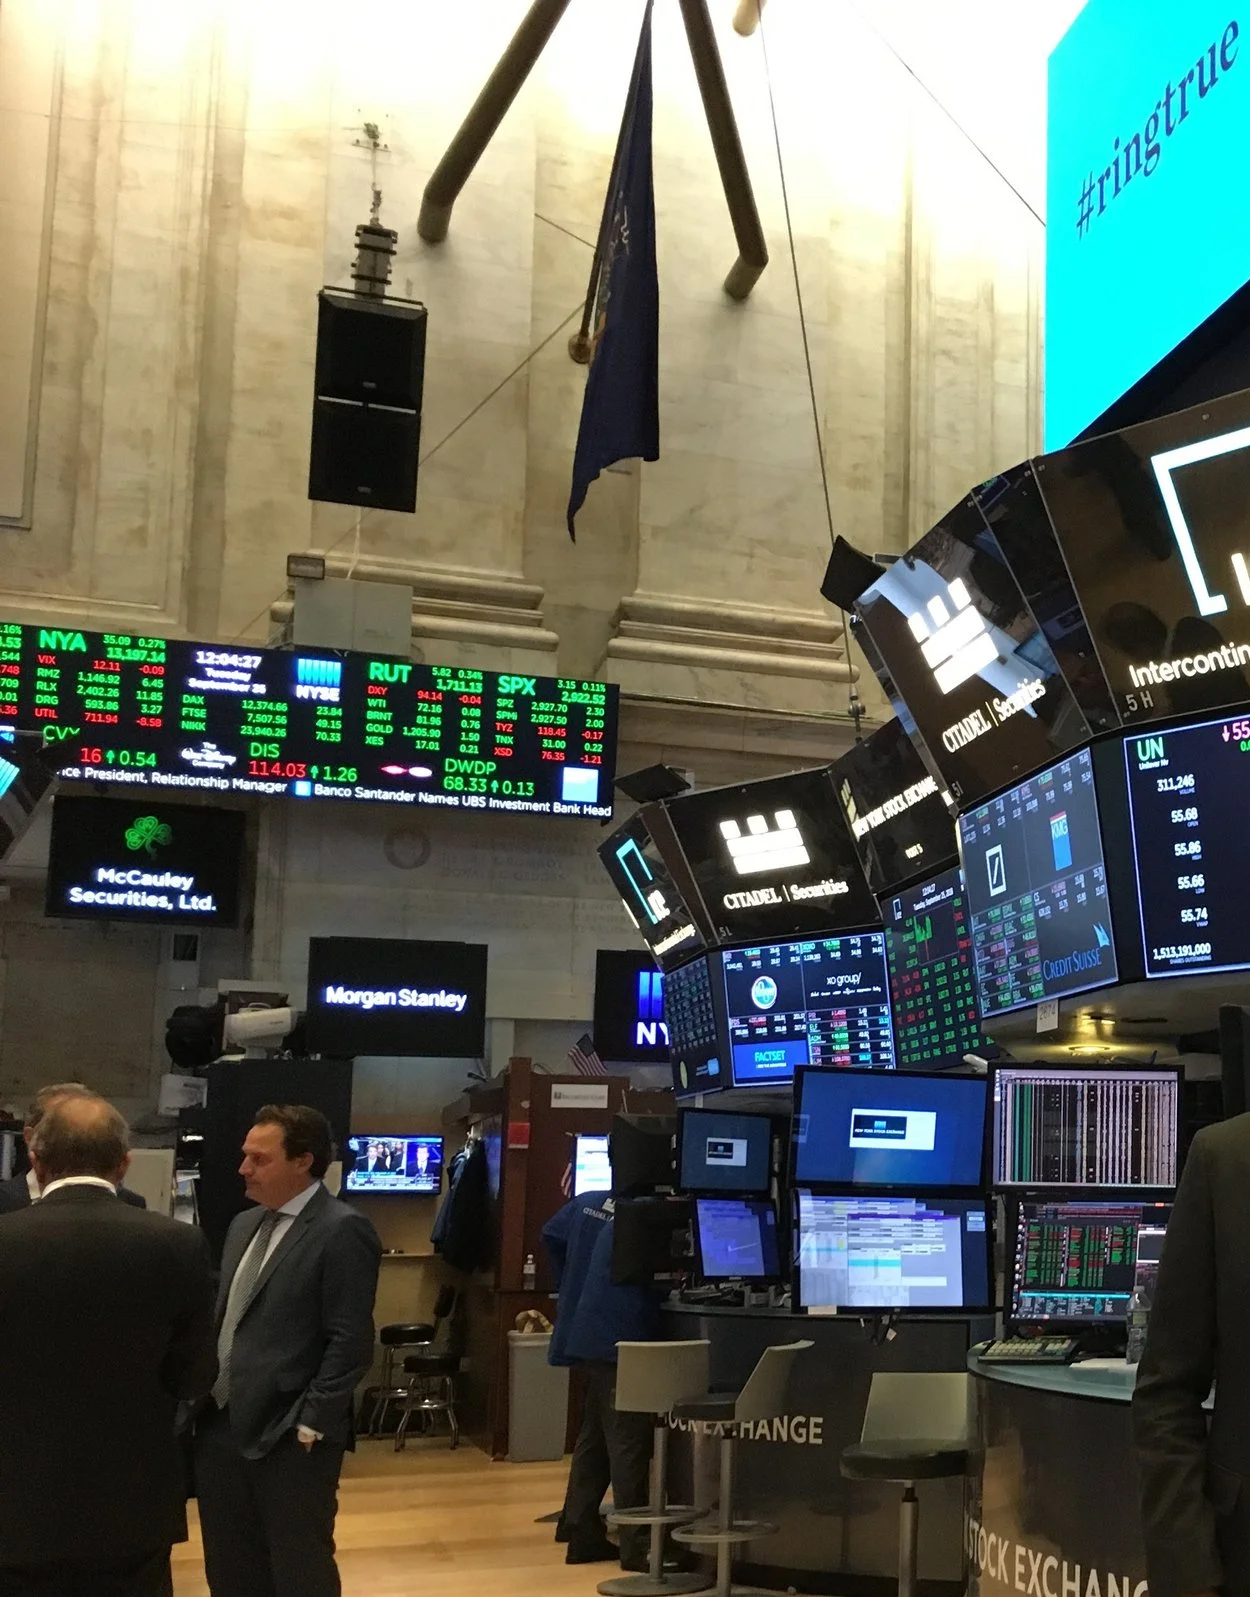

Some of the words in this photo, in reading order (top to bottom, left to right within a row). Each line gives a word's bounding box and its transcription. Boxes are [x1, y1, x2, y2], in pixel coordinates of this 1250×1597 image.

[1076, 20, 1240, 241] #ringtrue
[39, 630, 87, 652] NYA
[38, 655, 56, 664] VIX
[107, 648, 165, 663] 13,197.14
[196, 651, 262, 669] 12:04:27
[369, 662, 412, 683] RUT
[296, 684, 341, 702] NYSE
[436, 679, 483, 693] 1,711.13
[497, 675, 536, 696] SPX
[182, 695, 205, 705] DAX
[561, 691, 606, 705] 2,922.52
[182, 708, 207, 718] FTSE
[942, 709, 992, 753] CITADEL
[993, 678, 1046, 722] Securities
[181, 720, 206, 731] NIKK
[250, 743, 280, 758] DIS
[1137, 737, 1164, 762] UN
[249, 761, 307, 778] 114.03
[324, 766, 358, 782] 1.26
[445, 758, 496, 775] DWDP
[85, 768, 148, 784] President,
[152, 773, 229, 789] Relationship
[233, 779, 288, 793] Manager
[314, 784, 352, 797] Banco
[355, 787, 415, 802] Santander
[419, 795, 459, 806] Names
[462, 796, 486, 807] UBS
[489, 798, 551, 812] Investment
[554, 802, 580, 814] Bank
[584, 805, 612, 817] Head
[443, 777, 488, 792] 68.33
[502, 781, 534, 796] 0.13
[1157, 774, 1195, 793] 311,246
[1171, 808, 1198, 824] 55.68
[1051, 818, 1068, 838] KMG
[1174, 841, 1201, 856] 55.86
[97, 867, 194, 891] McCauley
[1178, 874, 1205, 889] 55.66
[69, 887, 174, 911] Securities,
[179, 894, 217, 912] Ltd.
[723, 887, 782, 910] CITADEL
[792, 878, 849, 900] Securities
[1181, 908, 1208, 923] 55.74
[1152, 943, 1211, 961] 1,513,191,000
[1043, 955, 1072, 982] CREDIT
[1072, 947, 1102, 974] SUISSE
[326, 986, 396, 1010] Morgan
[398, 988, 467, 1012] Stanley
[755, 1050, 786, 1062] FACTSET
[704, 1416, 824, 1445] EXHANGE
[969, 1518, 1009, 1584] STOCK
